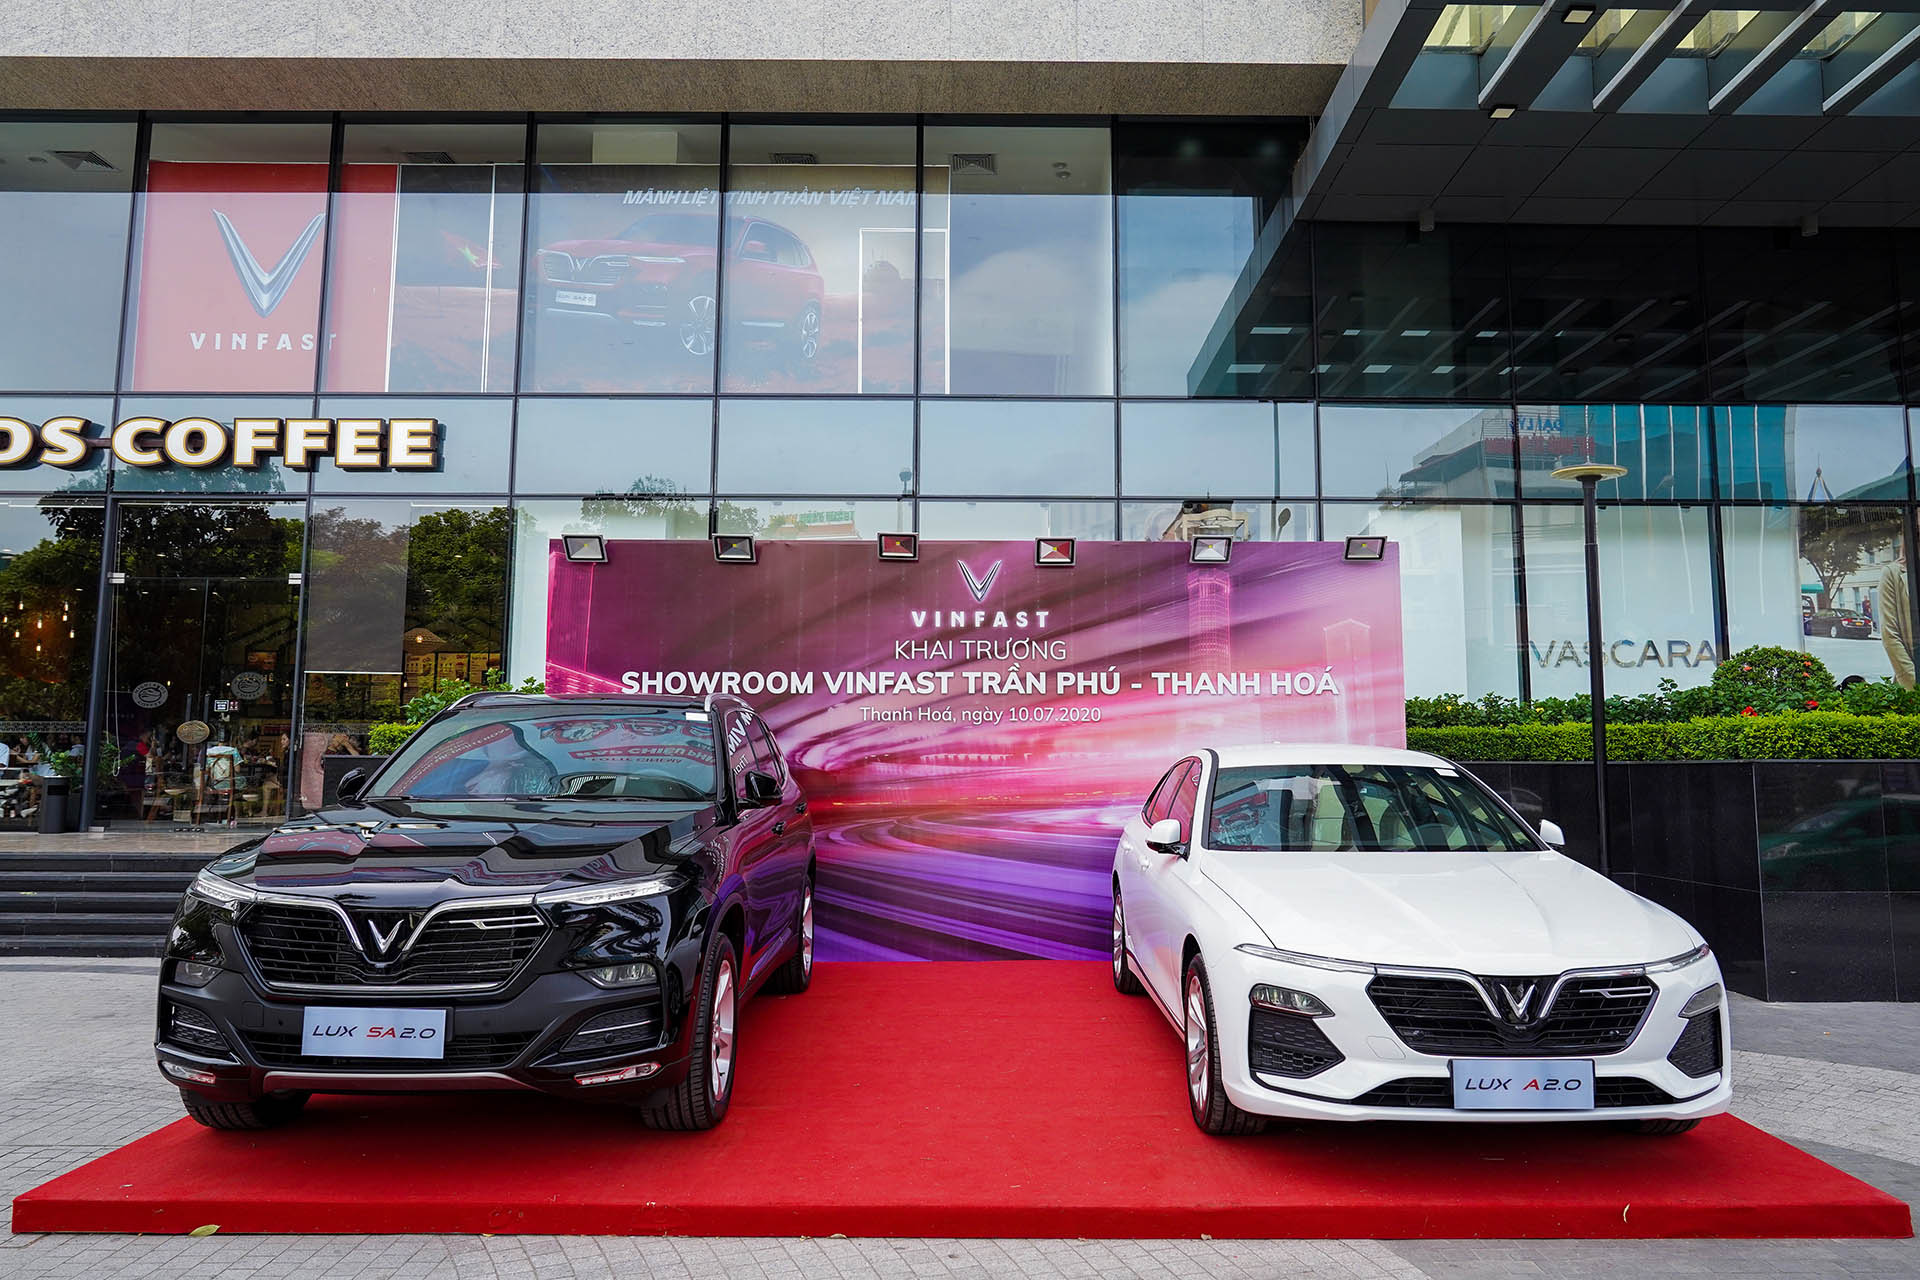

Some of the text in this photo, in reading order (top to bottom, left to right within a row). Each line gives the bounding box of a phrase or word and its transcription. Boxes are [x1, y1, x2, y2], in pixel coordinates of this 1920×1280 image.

[829, 187, 875, 208] VIỆT
[190, 332, 338, 351] VINFAST
[112, 416, 438, 468] COFFEE
[911, 610, 1050, 629] VINFAST
[895, 637, 1067, 661] KHAI TRƯƠNG
[621, 671, 814, 695] SHOWROOM
[822, 672, 955, 695] VINFAST
[963, 663, 1047, 695] TRẦN
[1058, 666, 1121, 695] PHÚ
[1151, 672, 1260, 695] THANH
[1271, 666, 1340, 695] HOÁ
[860, 706, 1102, 726] Thanh Hoá, ngày 10.07.2020
[312, 1024, 437, 1039] LUX SA2.0
[1465, 1078, 1582, 1091] LUX A2.0
